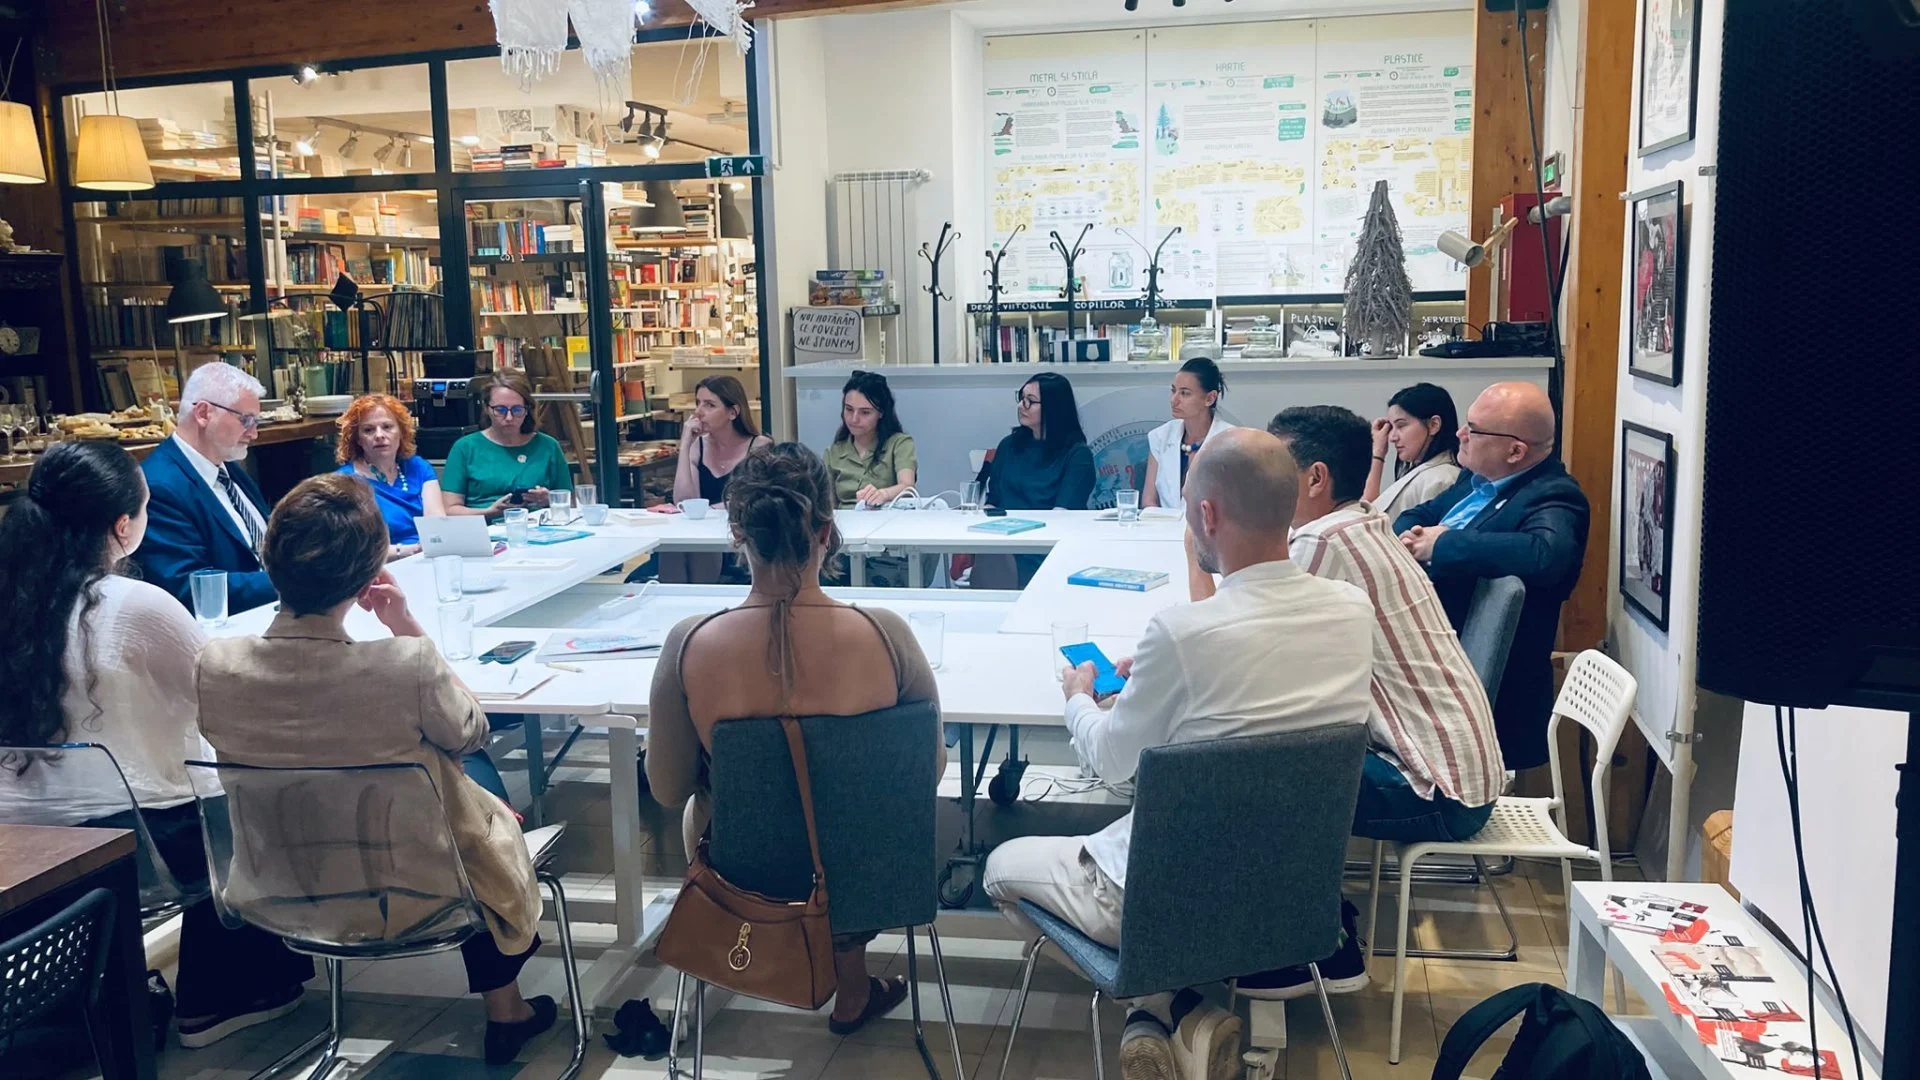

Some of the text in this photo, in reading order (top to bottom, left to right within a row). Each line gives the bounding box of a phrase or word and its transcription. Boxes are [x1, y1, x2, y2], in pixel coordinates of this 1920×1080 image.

[1384, 53, 1424, 64] PLASTICE
[1215, 61, 1246, 72] HARTIE
[1029, 72, 1058, 83] METAL
[1071, 70, 1098, 81] STICLA
[1002, 301, 1052, 311] VIITORUL
[800, 313, 813, 323] NOI
[1291, 313, 1335, 327] PLASTIC
[812, 324, 849, 336] POVESTE
[798, 336, 855, 351] NE SPUNEM
